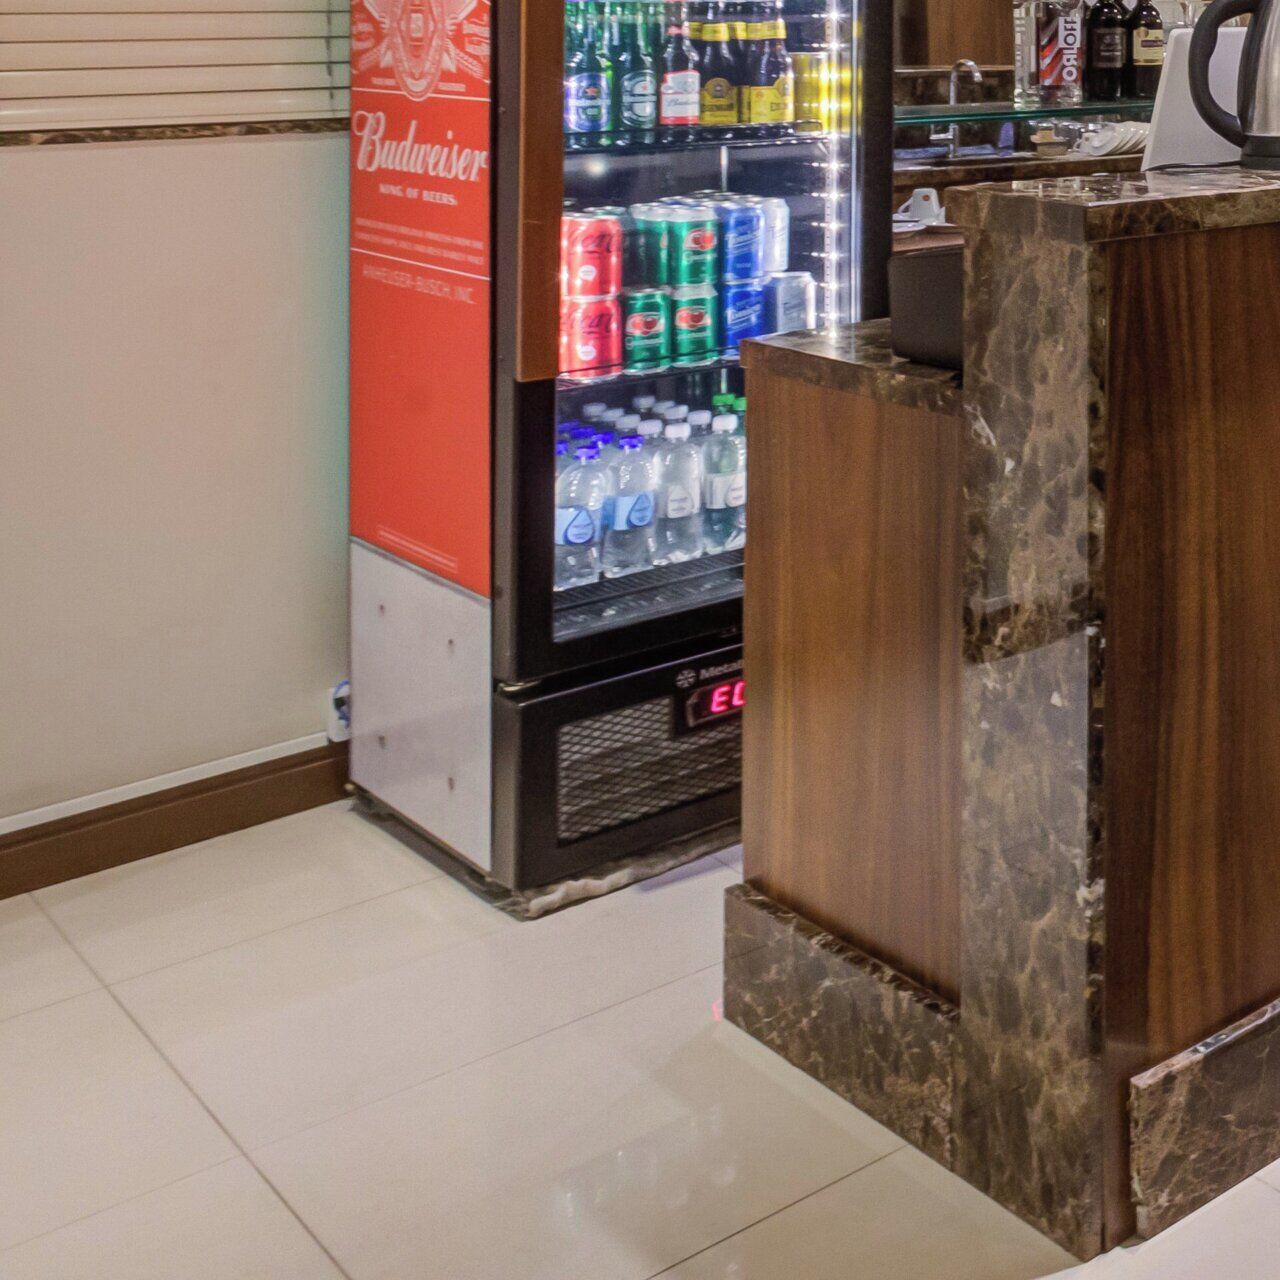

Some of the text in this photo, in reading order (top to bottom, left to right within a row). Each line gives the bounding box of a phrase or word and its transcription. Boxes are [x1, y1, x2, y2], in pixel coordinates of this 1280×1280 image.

[352, 110, 488, 182] Budweiser
[379, 183, 404, 197] KING
[406, 187, 420, 200] OF
